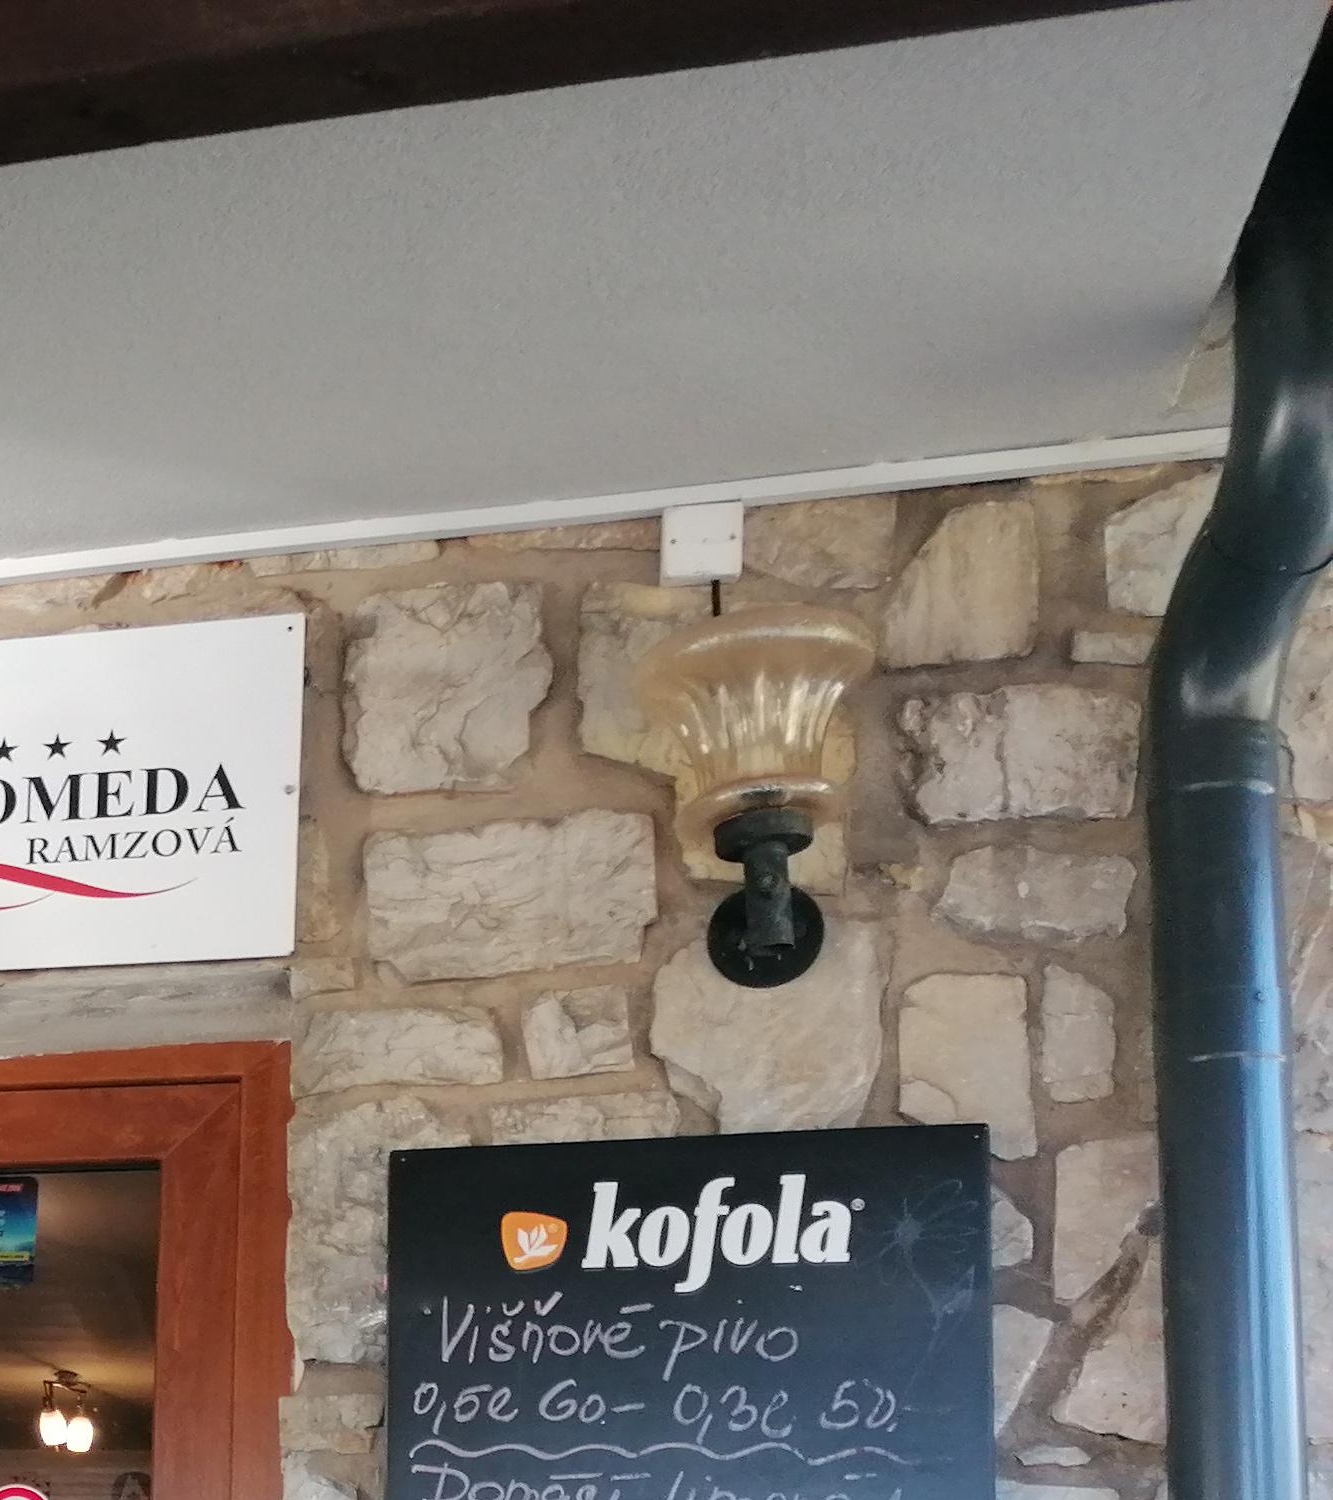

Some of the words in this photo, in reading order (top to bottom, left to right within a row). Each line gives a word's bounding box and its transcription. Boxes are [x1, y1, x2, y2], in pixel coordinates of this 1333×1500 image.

[26, 816, 243, 866] RAMZOVÁ
[581, 1173, 852, 1293] kofola
[658, 1312, 799, 1382] pivo
